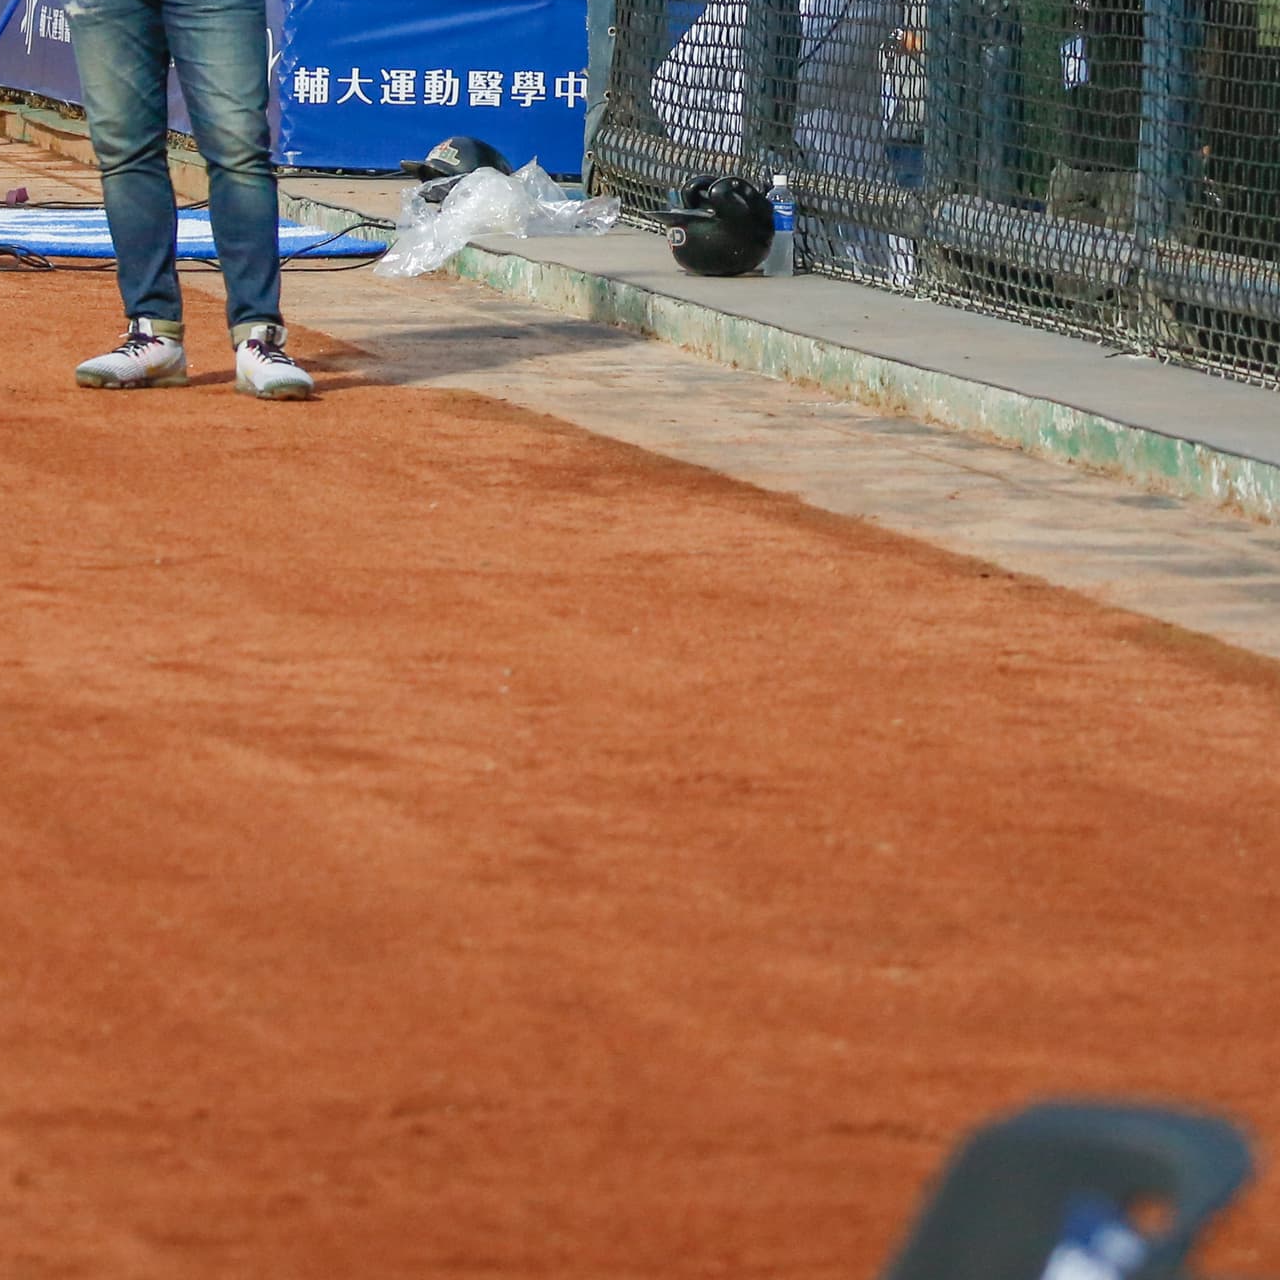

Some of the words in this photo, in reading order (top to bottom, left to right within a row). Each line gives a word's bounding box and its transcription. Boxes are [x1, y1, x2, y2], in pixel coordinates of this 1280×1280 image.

[293, 67, 588, 108] 輔大運動醫學中
